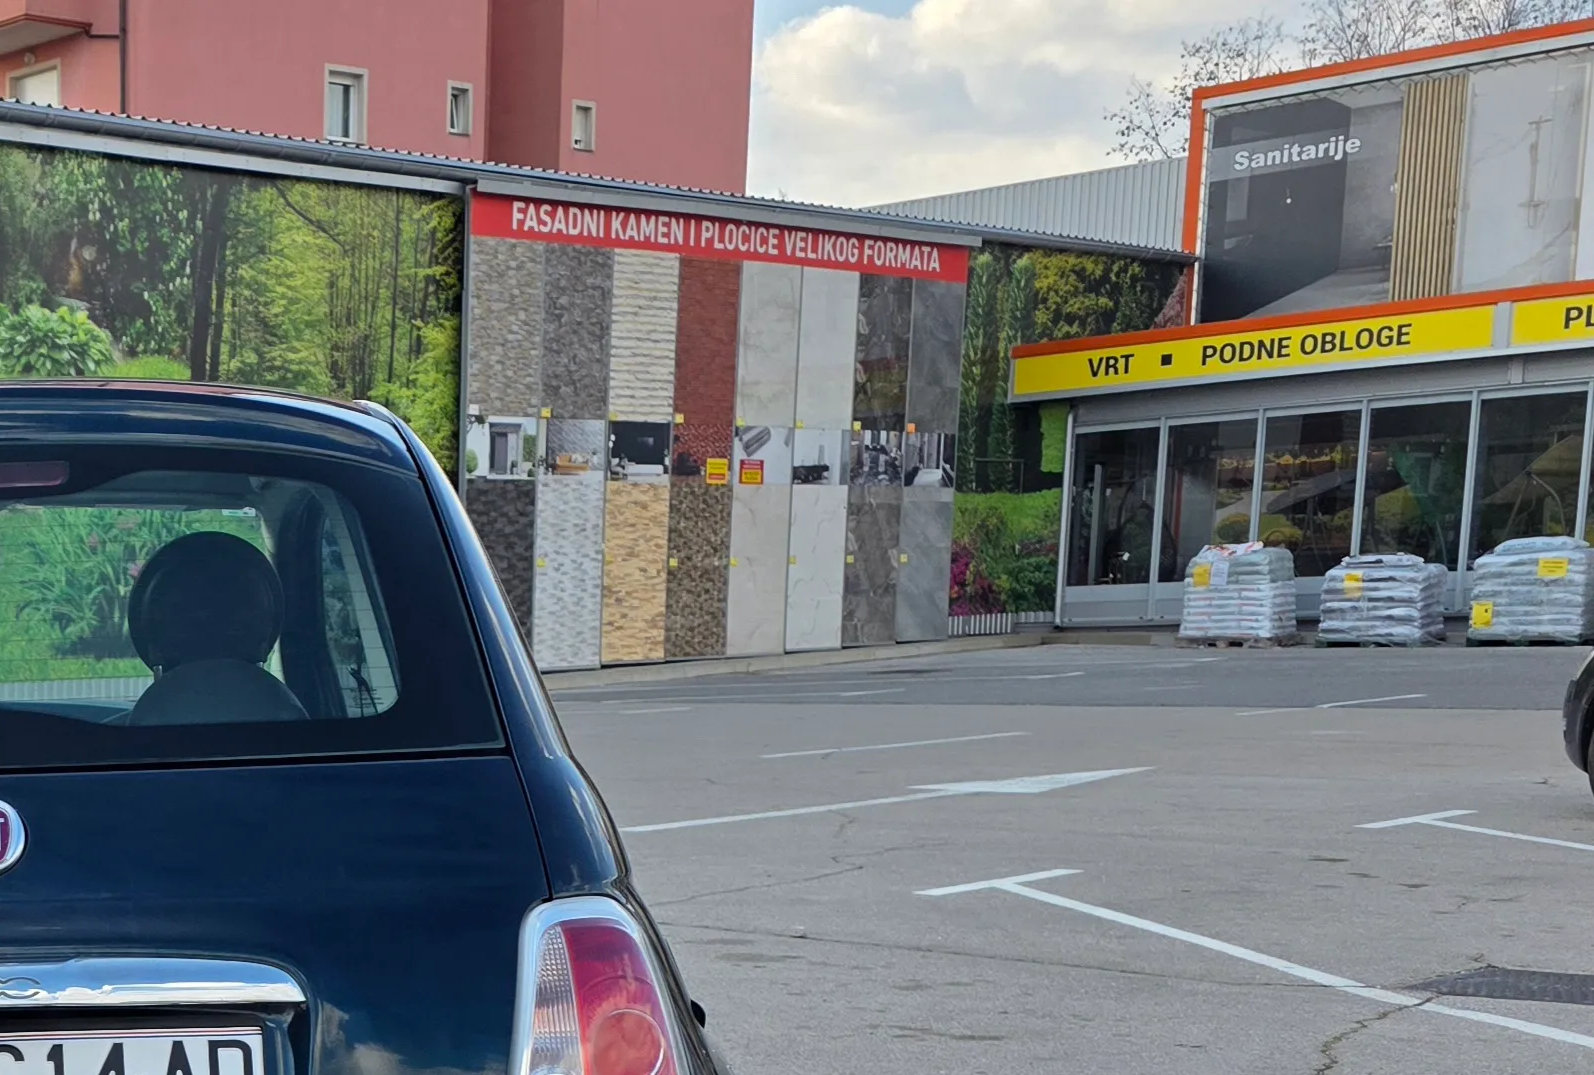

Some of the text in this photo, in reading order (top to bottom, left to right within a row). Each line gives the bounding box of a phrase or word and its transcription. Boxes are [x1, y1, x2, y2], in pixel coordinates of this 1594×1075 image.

[1233, 135, 1361, 172] Sanitarije
[512, 201, 605, 238] FASADNI
[611, 211, 684, 246] KAMEN
[689, 219, 696, 246] I
[784, 230, 859, 264] VELIKOG
[863, 240, 941, 272] FORMATA
[1088, 323, 1412, 377] VRT PODNE OBLOGE
